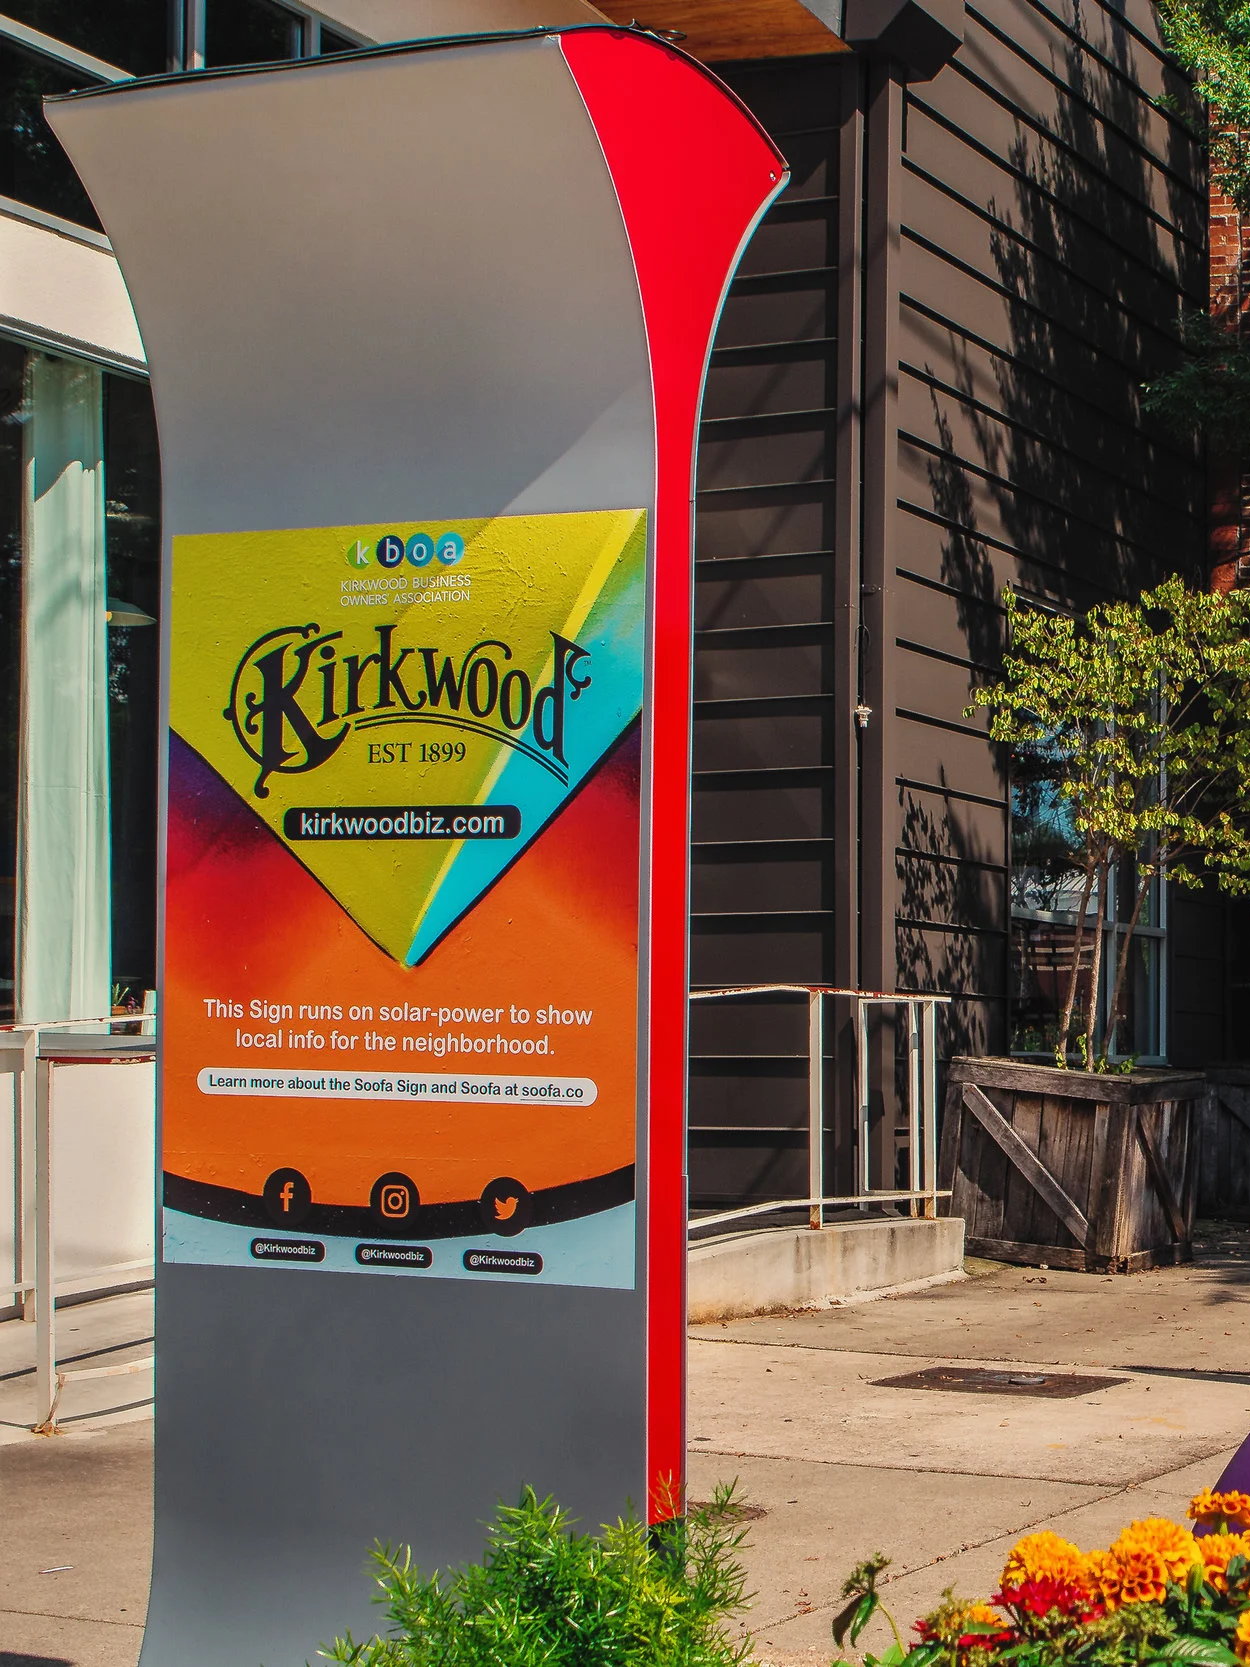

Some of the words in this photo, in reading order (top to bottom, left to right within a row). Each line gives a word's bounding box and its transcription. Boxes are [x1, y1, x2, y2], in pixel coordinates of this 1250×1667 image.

[340, 578, 408, 592] KIRKWOOD
[412, 575, 471, 589] BUSINESS
[393, 590, 471, 604] ASSOCIATION
[222, 622, 592, 798] Kirkwood
[368, 742, 412, 764] EST
[419, 742, 467, 763] 1899
[301, 811, 505, 835] kirkwoodbiz.com
[203, 999, 244, 1018] This
[249, 999, 293, 1024] Sign
[299, 1005, 343, 1020] runs
[348, 1005, 373, 1021] on
[379, 1002, 505, 1027] solar-power
[509, 1004, 531, 1024] to
[536, 1004, 593, 1025] show
[235, 1028, 283, 1048] local
[288, 1029, 326, 1049] info
[330, 1030, 359, 1050] for
[364, 1031, 396, 1051] the
[402, 1032, 555, 1057] neighborhood.
[209, 1074, 247, 1087] Learn
[250, 1077, 284, 1089] more
[288, 1076, 326, 1090] about
[329, 1077, 350, 1091] the
[354, 1078, 393, 1092] Soofa
[397, 1079, 427, 1095] Sign
[431, 1081, 457, 1094] and
[460, 1081, 500, 1095] Soofa
[505, 1083, 519, 1096] at
[521, 1084, 584, 1098] soofa.co
[255, 1243, 316, 1255] @Kirkwoodbiz
[361, 1249, 424, 1262] @Kirkwoodbiz
[469, 1255, 535, 1267] @Kirkwoodbiz
